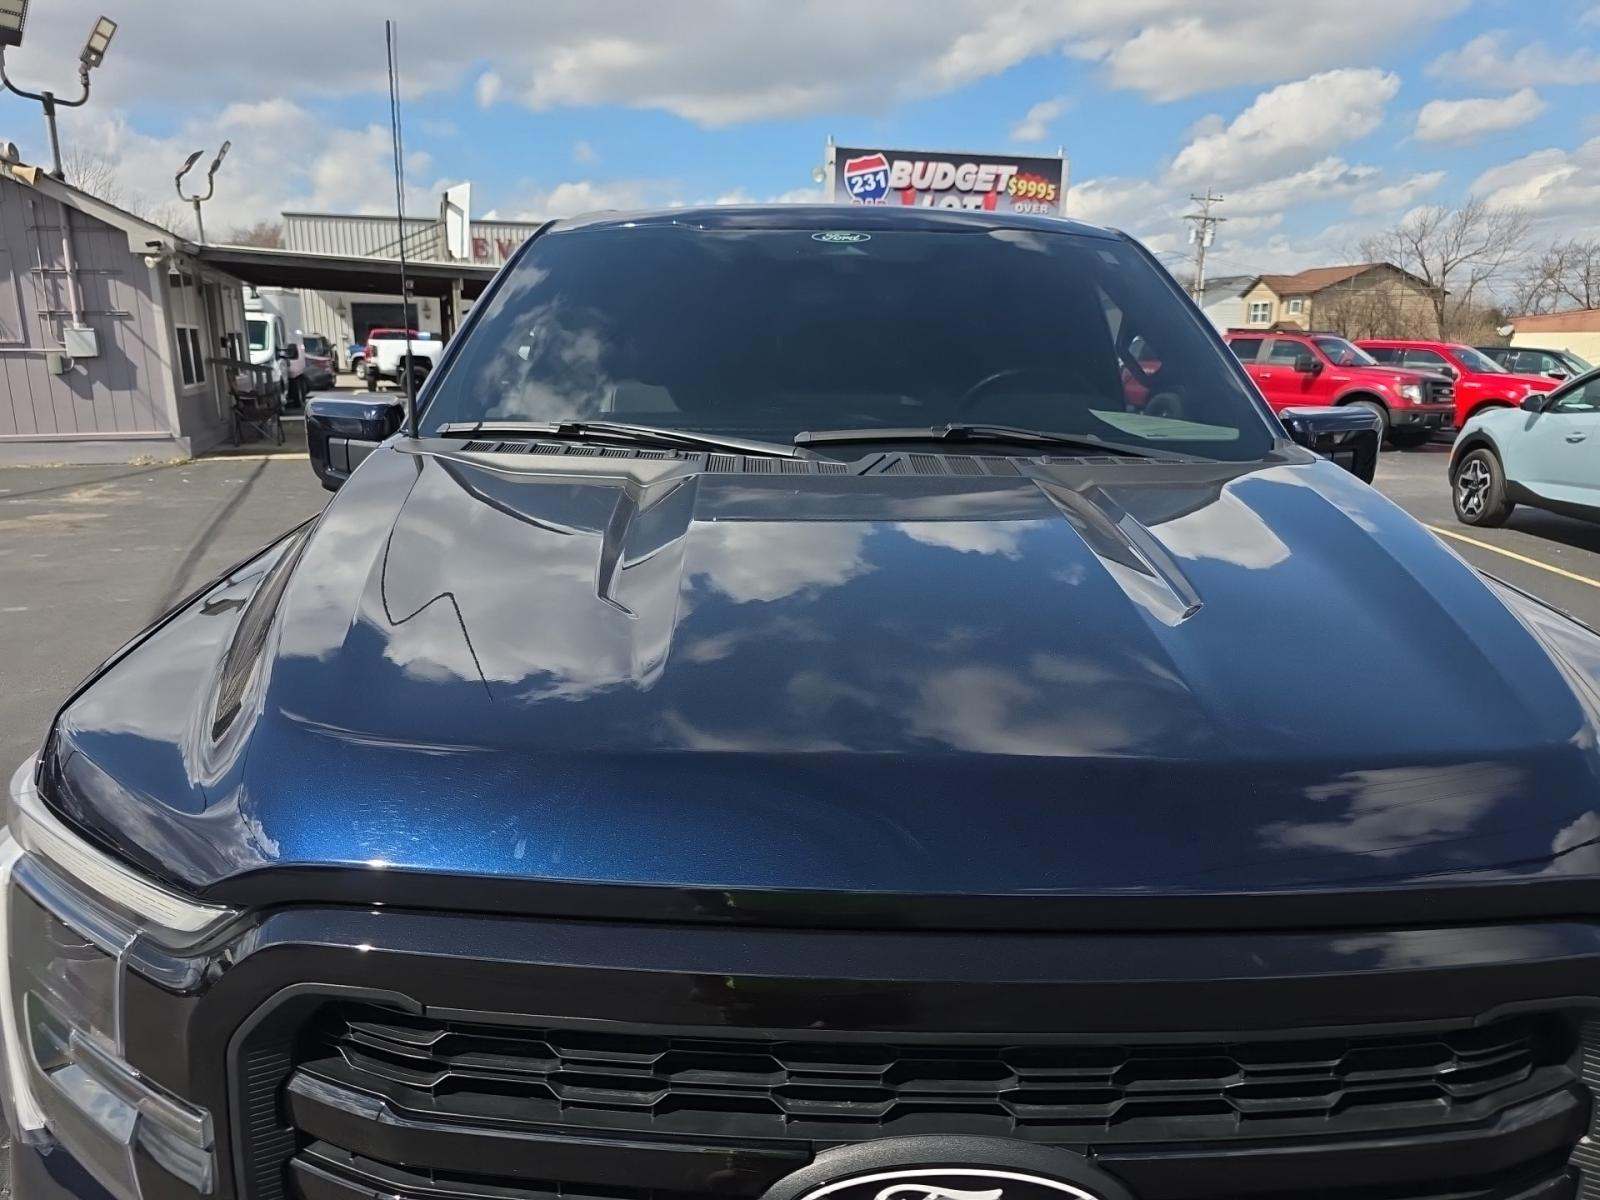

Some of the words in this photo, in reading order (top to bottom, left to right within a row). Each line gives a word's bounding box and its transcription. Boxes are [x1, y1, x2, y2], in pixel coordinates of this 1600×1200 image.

[851, 171, 886, 194] 231
[890, 160, 1018, 193] BUDGET
[1007, 176, 1056, 200] $9995
[1014, 202, 1049, 214] OVER
